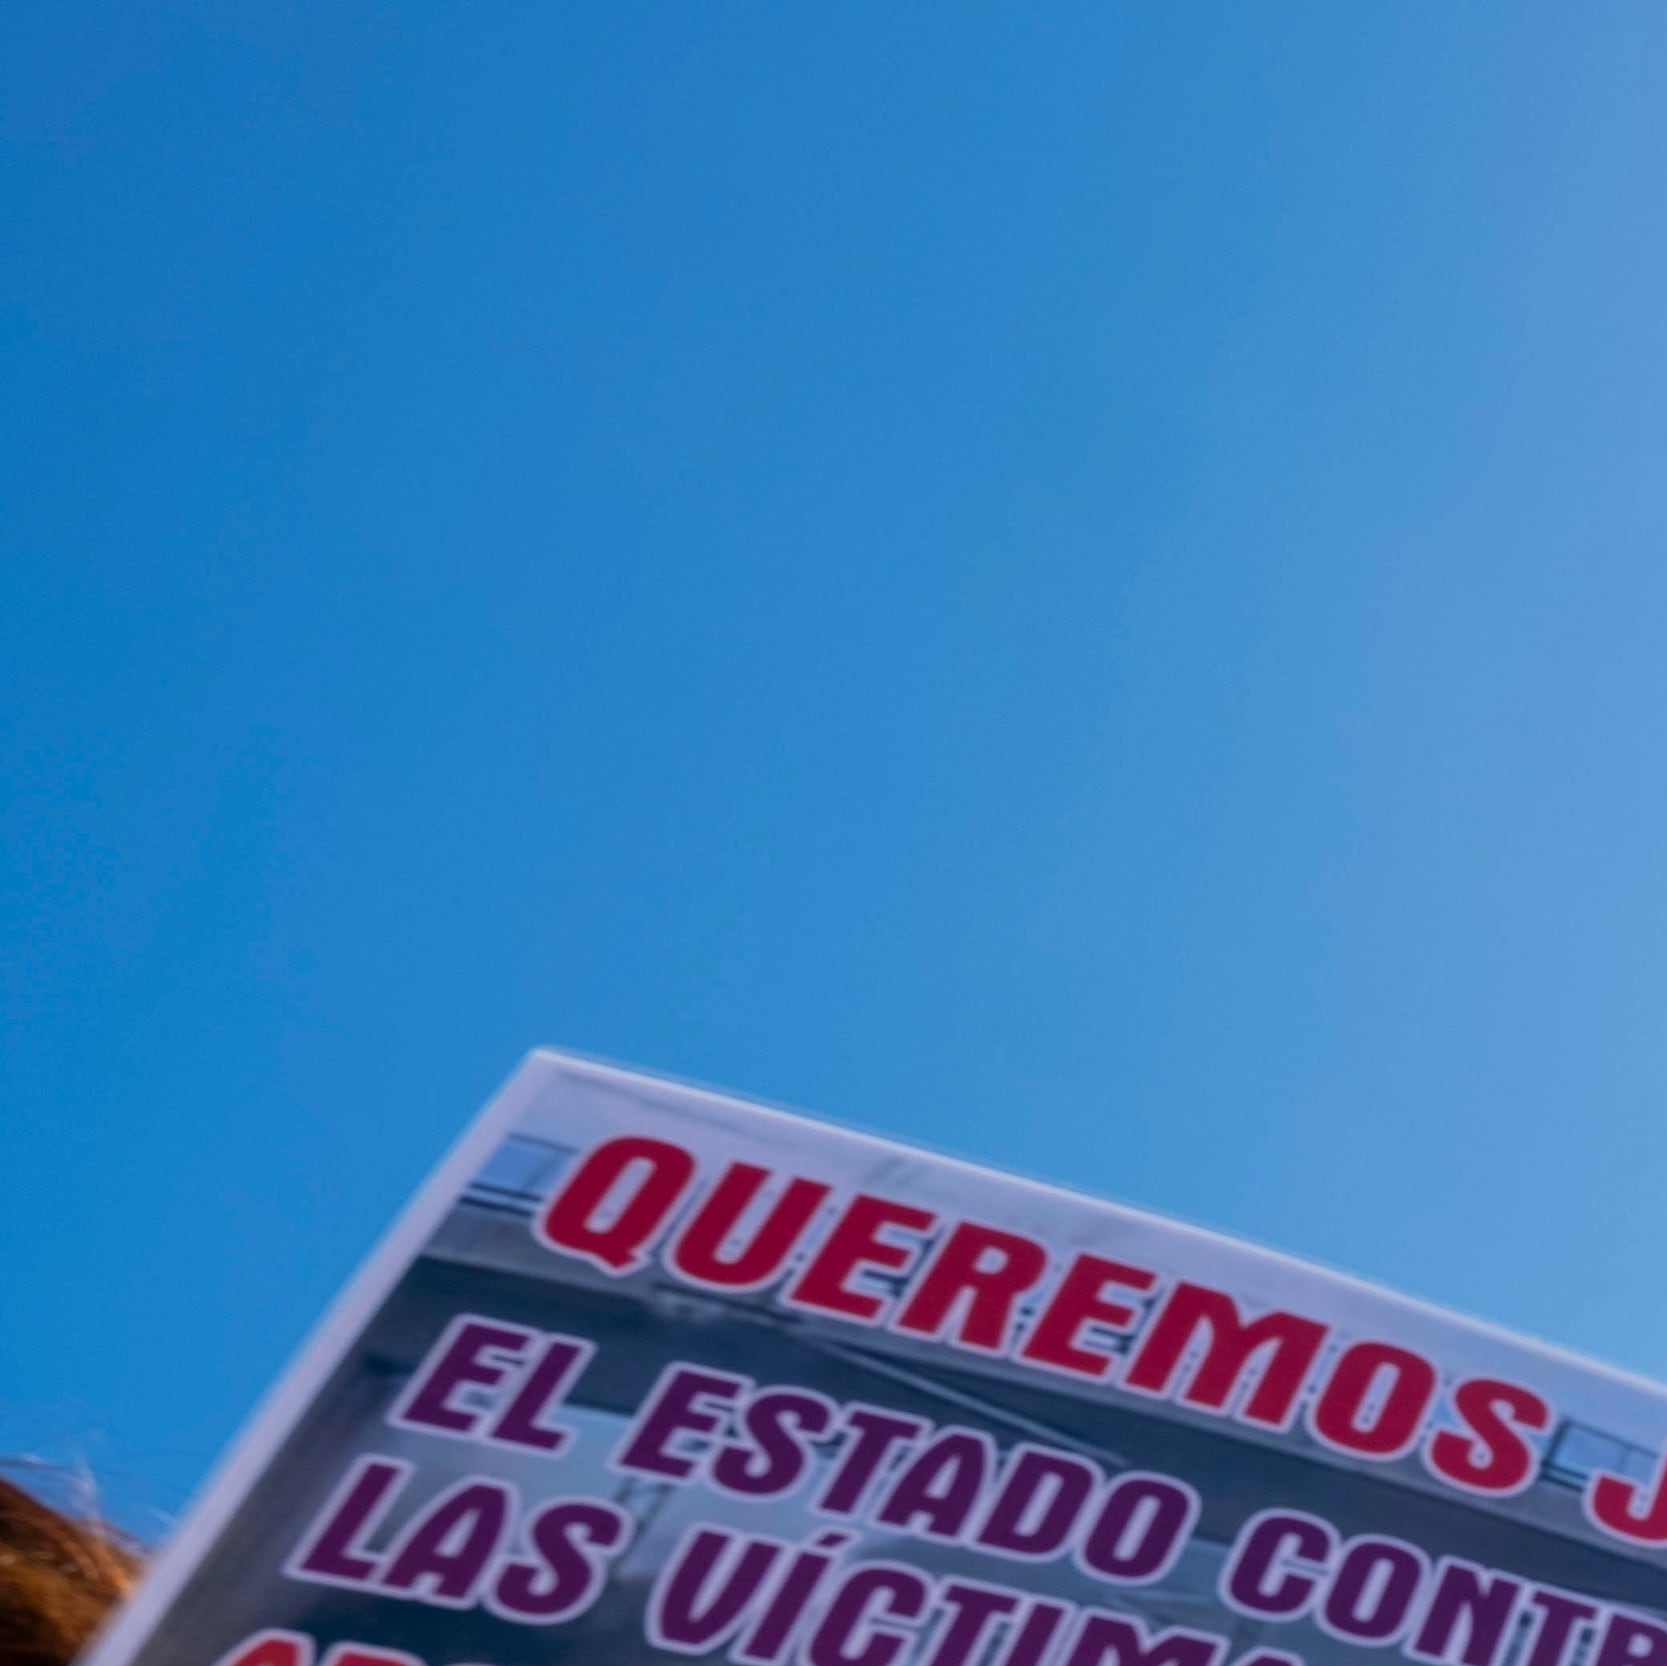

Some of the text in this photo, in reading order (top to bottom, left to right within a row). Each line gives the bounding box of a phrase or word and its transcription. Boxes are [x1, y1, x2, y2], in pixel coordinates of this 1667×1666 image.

[391, 1313, 596, 1455] EL
[619, 1364, 1202, 1588] ESTADO
[536, 1133, 1550, 1495] QUEREMOS
[286, 1454, 631, 1625] LAS
